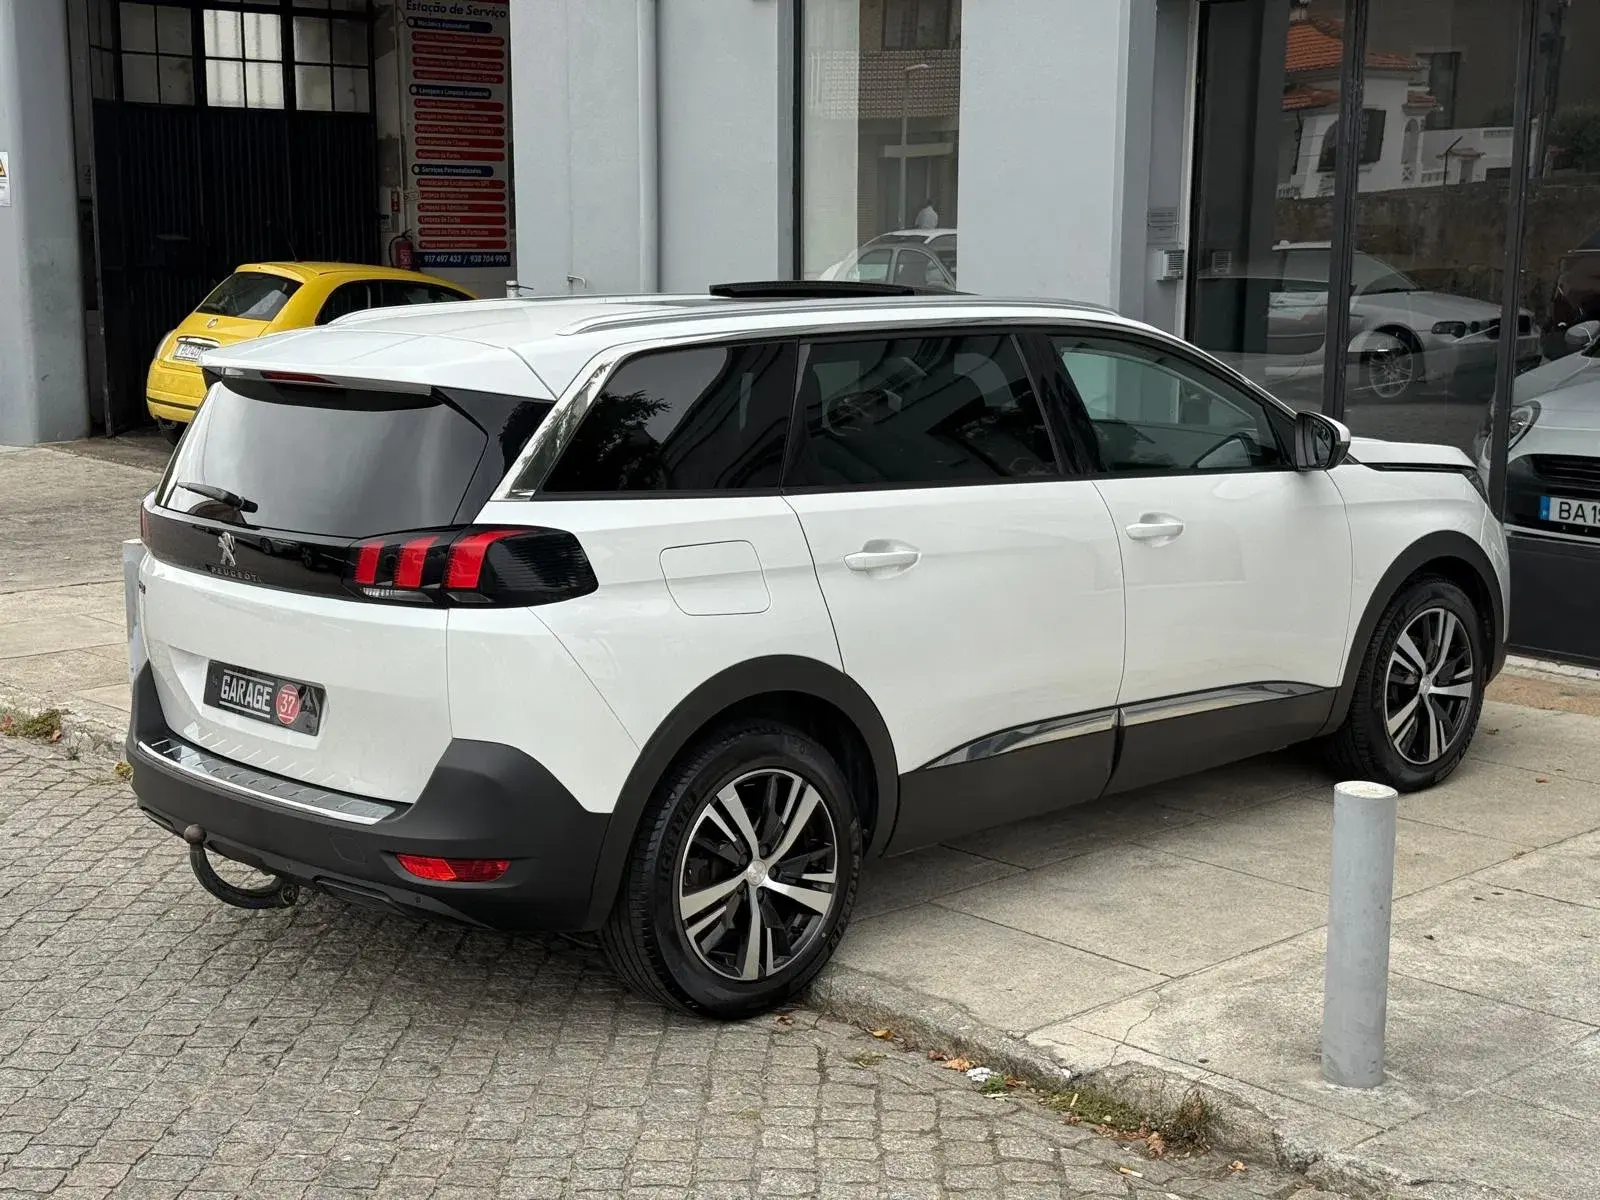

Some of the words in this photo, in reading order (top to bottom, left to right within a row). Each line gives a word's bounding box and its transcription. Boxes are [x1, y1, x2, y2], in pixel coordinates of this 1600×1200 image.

[406, 1, 446, 13] Estação
[449, 4, 463, 15] de
[466, 5, 506, 19] Serviço
[421, 167, 444, 175] Serviços
[445, 167, 482, 175] Personalizados
[424, 254, 435, 263] 917
[436, 254, 448, 263] 497
[470, 254, 482, 263] 938
[482, 254, 494, 263] 704
[495, 254, 507, 263] 990
[1559, 501, 1587, 523] BA
[1591, 504, 1600, 524] 1
[211, 566, 258, 582] PEUGEOT
[220, 675, 272, 712] GARAGE
[279, 693, 296, 715] 37
